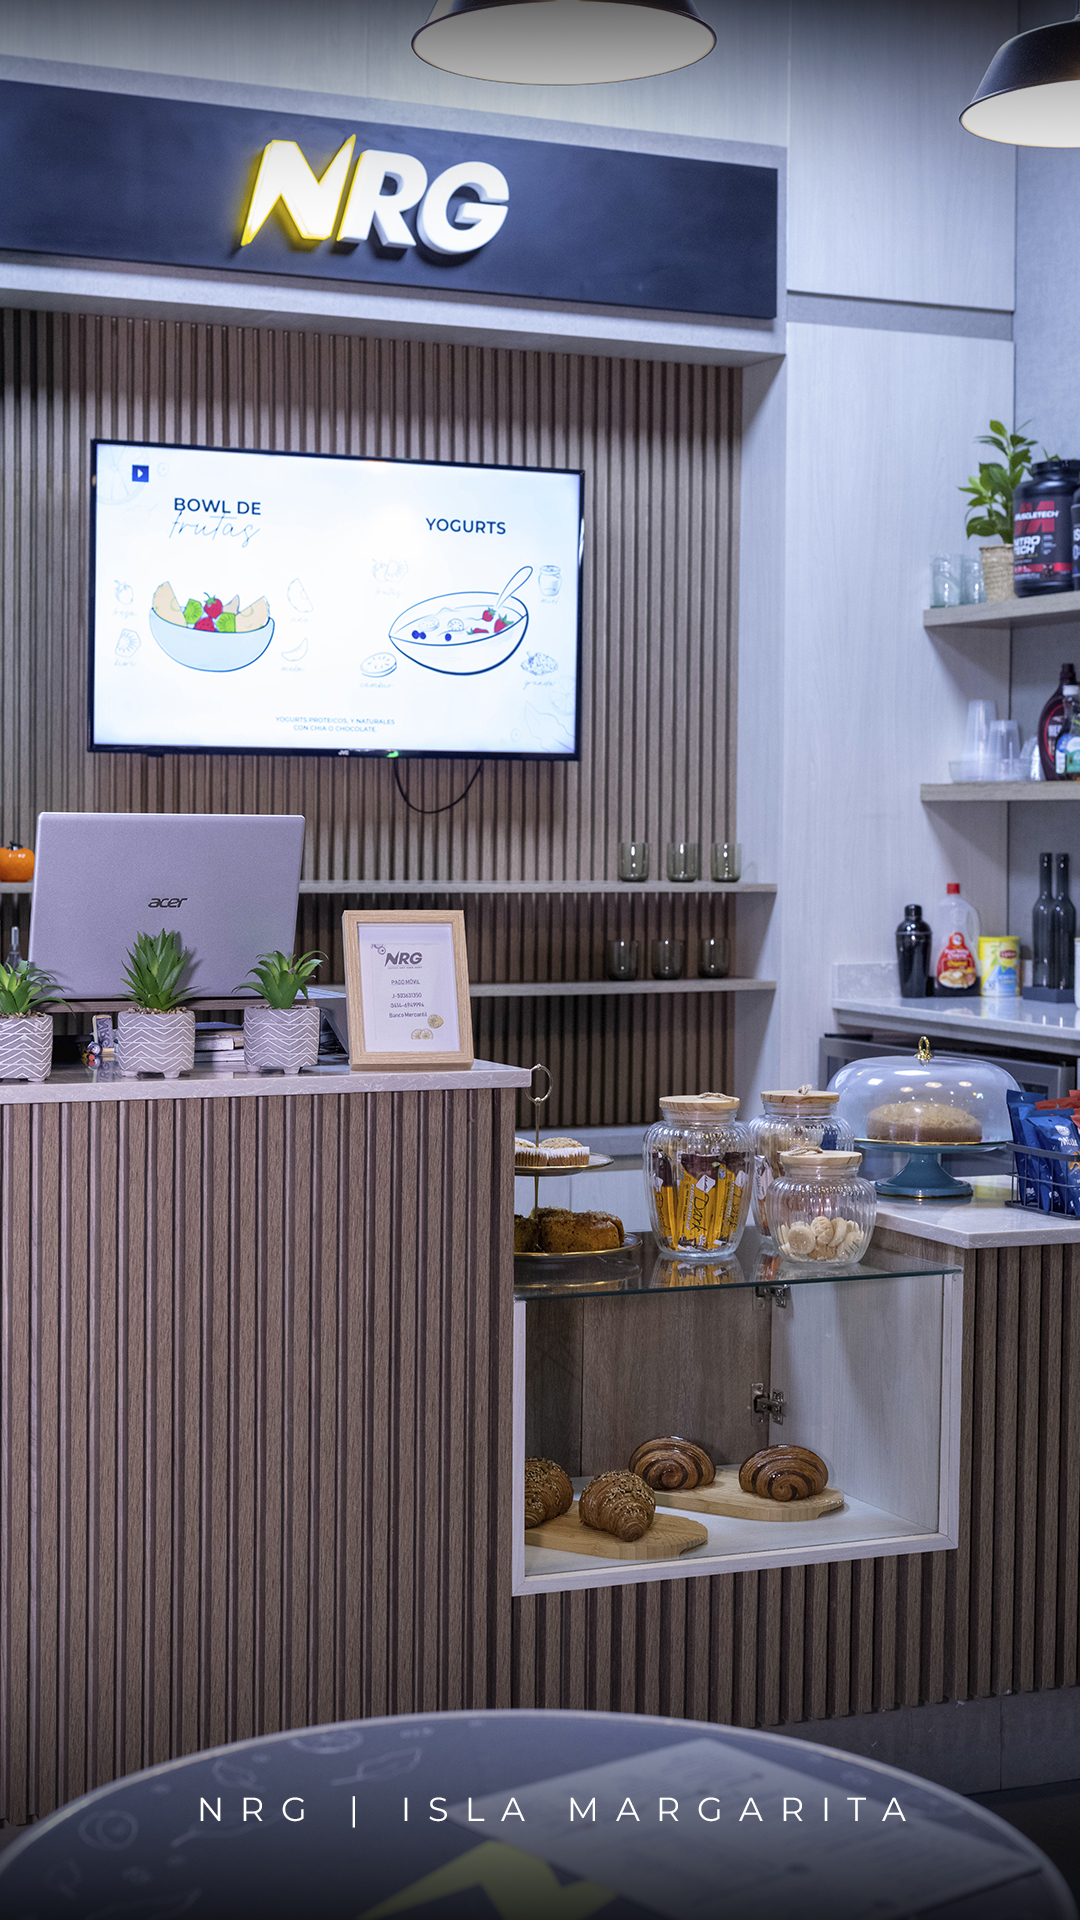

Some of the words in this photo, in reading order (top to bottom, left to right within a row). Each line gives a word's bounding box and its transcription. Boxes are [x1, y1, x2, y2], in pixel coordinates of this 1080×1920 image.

[241, 134, 509, 254] NRG
[174, 497, 231, 513] BOWL
[237, 501, 261, 515] DE
[169, 511, 260, 548] frutas
[425, 517, 506, 535] YOGURTS
[148, 898, 188, 908] acer
[385, 951, 423, 967] NRG
[690, 1193, 709, 1231] Dark
